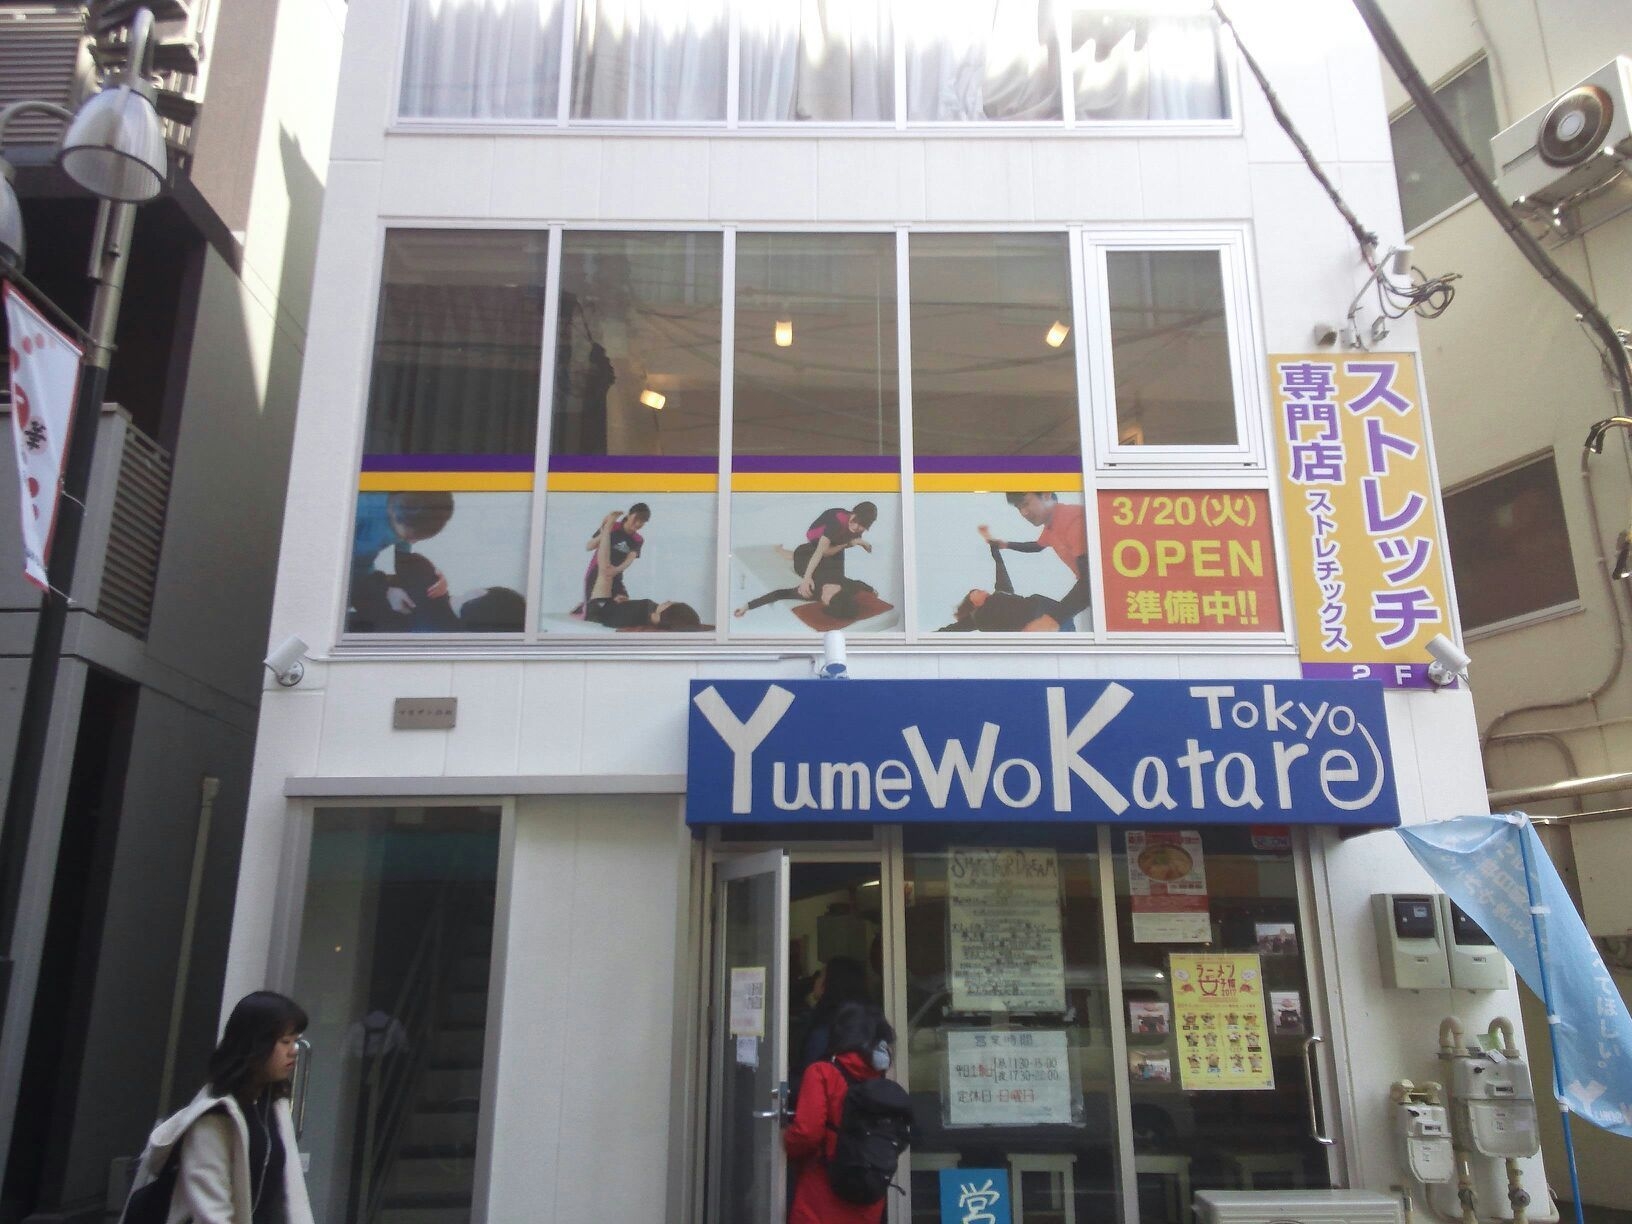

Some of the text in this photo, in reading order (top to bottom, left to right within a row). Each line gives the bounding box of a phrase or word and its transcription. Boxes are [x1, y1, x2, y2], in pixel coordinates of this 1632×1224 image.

[1280, 361, 1344, 483] 専門店
[1112, 495, 1257, 528] 3/20(火)
[1345, 361, 1440, 648] ストレッチ
[1112, 538, 1264, 578] OPEN
[1307, 491, 1350, 651] ストレチックス
[1126, 590, 1260, 625] 準備中!!
[1189, 685, 1356, 739] Tokyo
